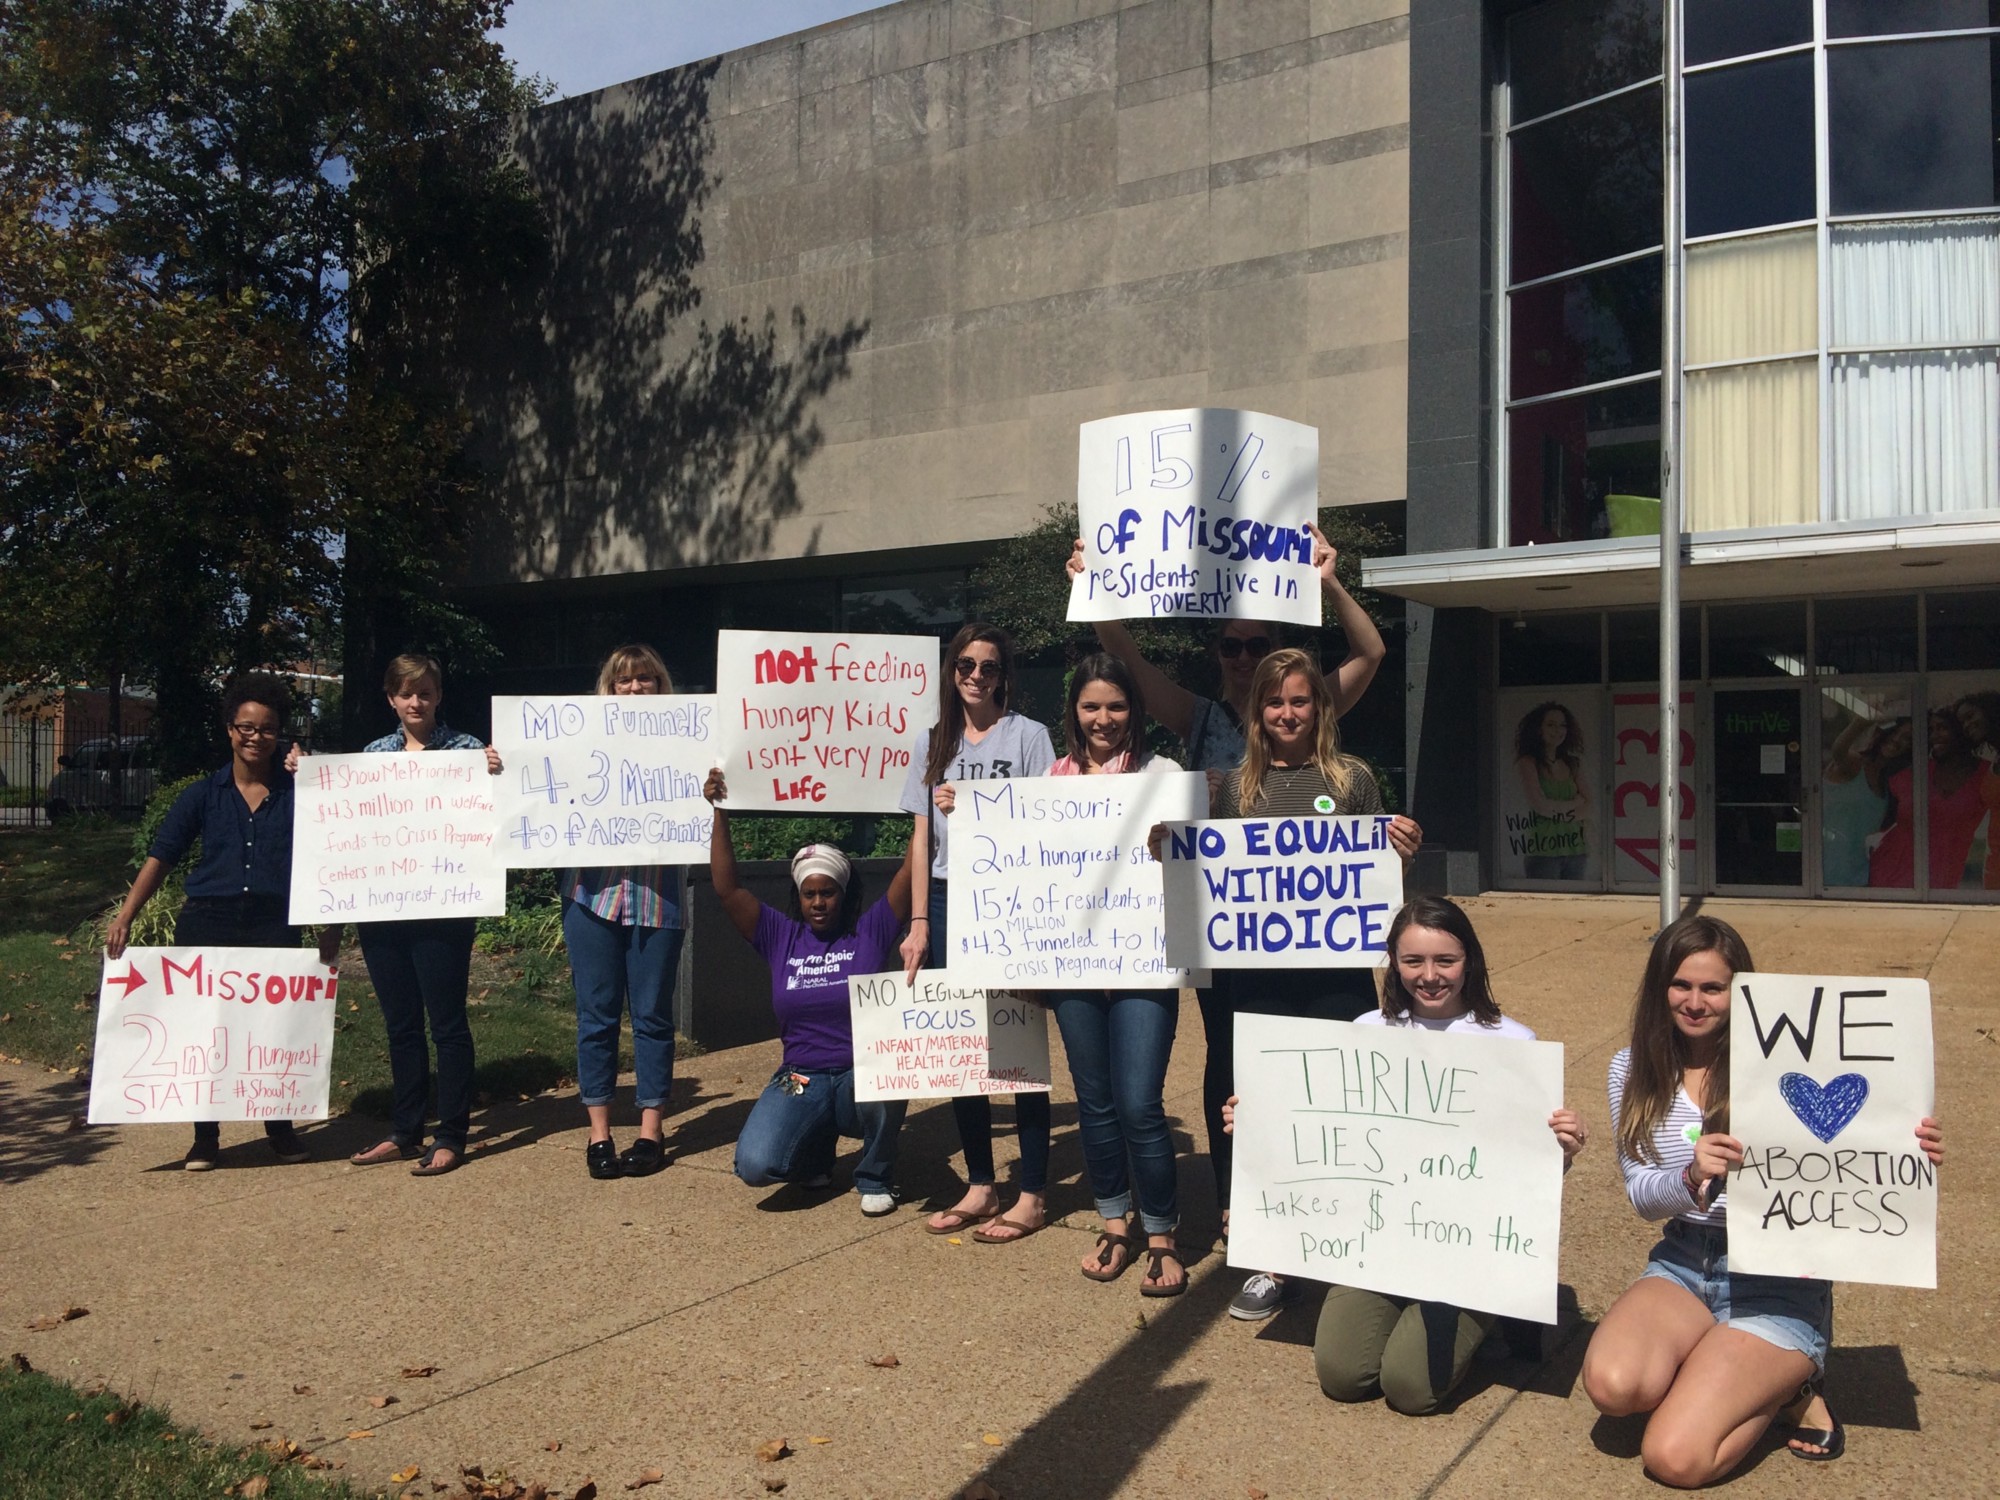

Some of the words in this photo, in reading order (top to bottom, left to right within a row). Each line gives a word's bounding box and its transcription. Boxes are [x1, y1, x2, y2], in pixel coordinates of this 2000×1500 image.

[1115, 423, 1270, 503] 15%
[1096, 508, 1142, 554] of
[1162, 504, 1312, 565] Missouri
[1088, 558, 1200, 600] residents
[1215, 567, 1259, 594] live
[1150, 591, 1232, 616] POVERTY
[754, 646, 818, 685] not
[824, 642, 927, 696] feeding
[522, 700, 585, 740] MO
[604, 702, 712, 741] Funnels
[742, 697, 834, 742] hungry
[845, 700, 908, 734] Kids
[309, 760, 474, 791] #ShowMePriorities
[521, 749, 610, 806] 4.3
[814, 745, 871, 778] very
[878, 746, 910, 779] pro
[957, 758, 984, 780] in
[359, 792, 413, 817] million
[425, 796, 442, 812] in
[451, 795, 494, 812] welfare
[973, 782, 1123, 823] Missouri:
[321, 831, 366, 853] funds
[371, 831, 391, 848] to
[396, 826, 437, 847] Crisis
[444, 824, 493, 849] Pregnancy
[509, 815, 557, 849] to
[1170, 825, 1226, 860] NO
[1509, 827, 1586, 856] Welcome!
[318, 865, 367, 885] Centers
[374, 864, 386, 877] in
[431, 856, 466, 875] the
[972, 835, 1032, 875] 2nd
[1039, 840, 1121, 878] hungriest
[319, 889, 357, 913] 2nd
[368, 885, 436, 912] hungriest
[441, 882, 484, 906] state
[1201, 862, 1375, 903] WITHOUT
[972, 884, 1022, 922] 15%
[1032, 882, 1060, 913] of
[1065, 886, 1141, 911] residents
[1005, 914, 1066, 933] MILLION
[1020, 927, 1099, 952] funneled
[1108, 928, 1142, 950] to
[1207, 903, 1389, 953] CHOICE
[160, 954, 339, 1005] Missouri
[796, 963, 840, 976] America
[1004, 957, 1048, 980] crisis
[1054, 955, 1123, 979] pregnancy
[856, 979, 897, 1008] MO
[902, 1009, 976, 1031] FOCUS
[1740, 984, 1896, 1063] WE
[122, 1013, 228, 1079] 2nd
[247, 1031, 324, 1080] hungriest
[896, 1054, 944, 1071] HEALTH
[949, 1054, 987, 1068] CARE
[123, 1079, 226, 1115] STATE
[233, 1080, 301, 1100] #ShowMe
[876, 1074, 919, 1090] LIVING
[978, 1078, 1048, 1093] DISPARITIES
[1260, 1047, 1479, 1115] THRIVE
[245, 1099, 318, 1118] Priorities
[1419, 1146, 1484, 1181] and
[1736, 1145, 1934, 1191] ABORTION
[1255, 1190, 1340, 1219] takes
[1363, 1188, 1385, 1234] $
[1404, 1200, 1472, 1246] from
[1488, 1215, 1540, 1259] the
[1761, 1189, 1909, 1237] ACCESS
[1300, 1230, 1366, 1269] poor!
